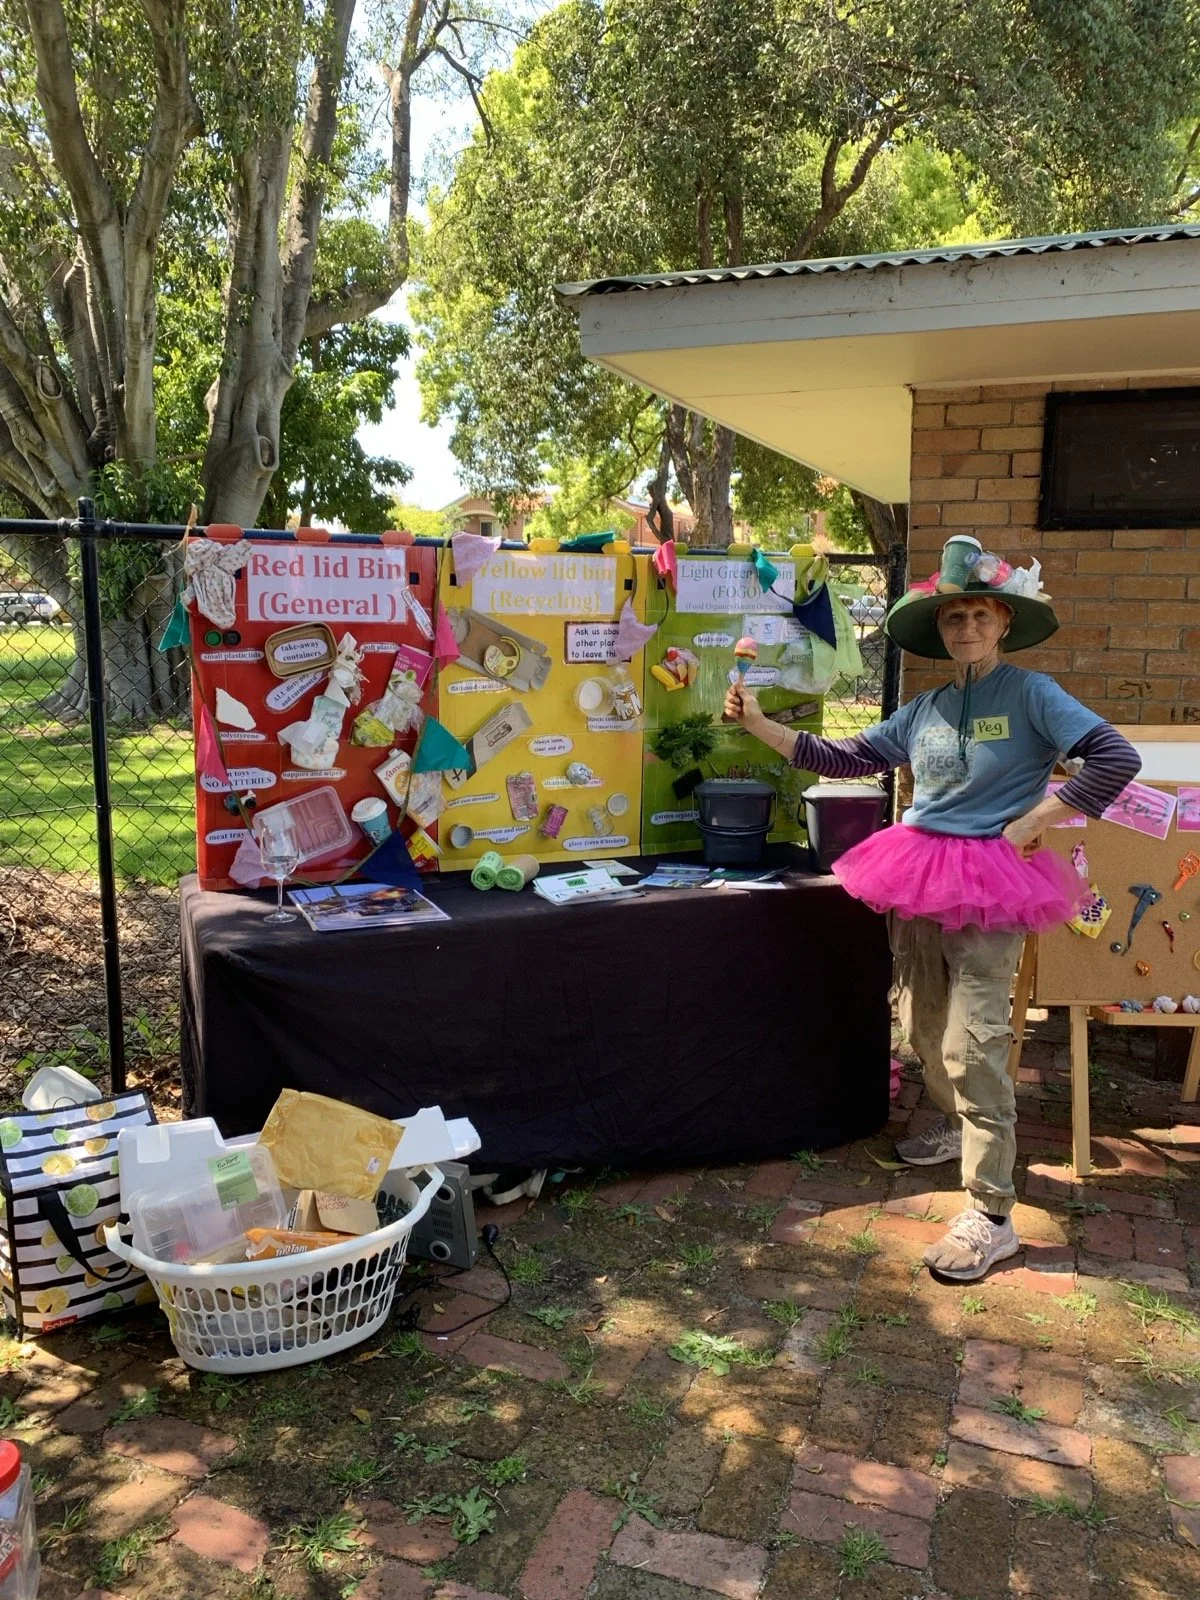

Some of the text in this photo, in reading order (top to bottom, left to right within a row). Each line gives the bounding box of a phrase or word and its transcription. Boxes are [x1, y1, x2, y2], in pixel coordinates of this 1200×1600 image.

[252, 554, 401, 579] Red lid Bin
[481, 560, 611, 581] Yellow lid bin
[681, 565, 713, 581] Light
[718, 565, 753, 579] Green
[712, 585, 761, 600] (FOGO)
[490, 590, 602, 613] (Recycling)
[281, 641, 319, 650] take-away
[282, 651, 322, 661] containers
[977, 720, 1003, 736] Peg
[927, 755, 955, 769] PEG
[205, 780, 219, 789] NO
[473, 829, 503, 837] luminium
